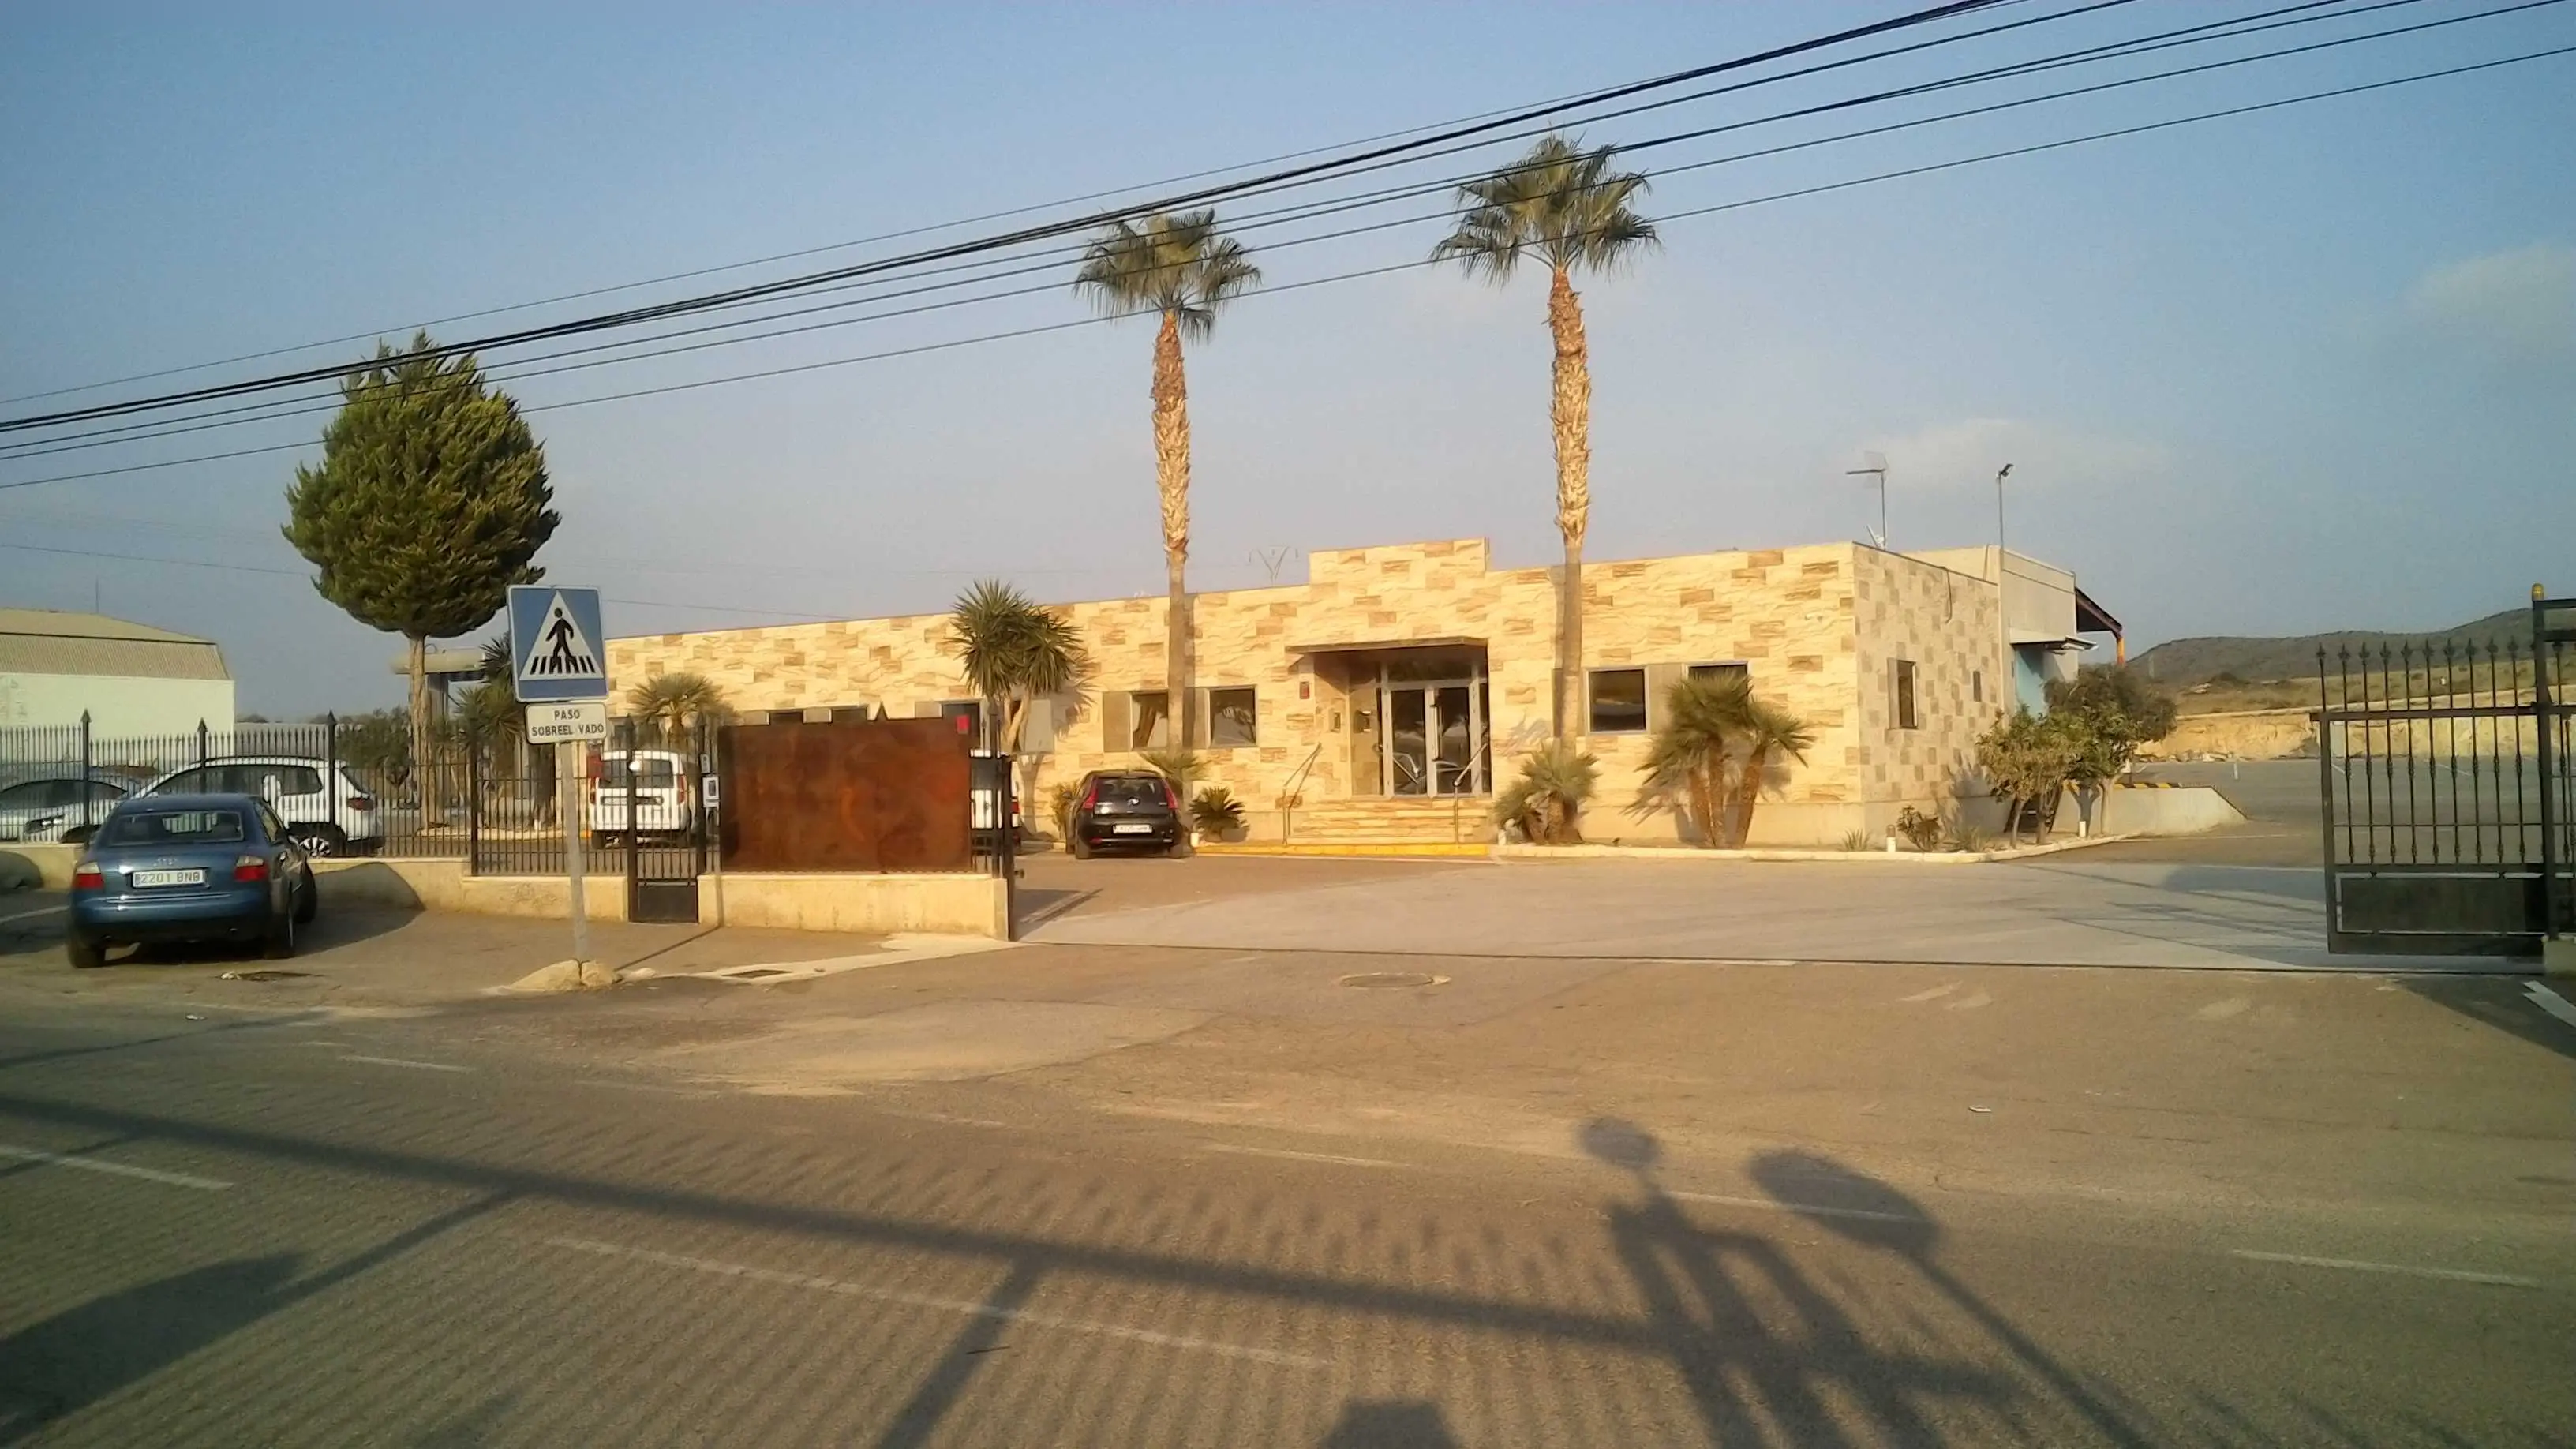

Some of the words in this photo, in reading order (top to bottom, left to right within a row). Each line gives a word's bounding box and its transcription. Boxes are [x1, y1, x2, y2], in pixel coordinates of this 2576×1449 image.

[554, 710, 581, 720] PASO
[531, 724, 573, 736] SOBREEL
[578, 724, 604, 734] VADO
[141, 873, 170, 883] 2201
